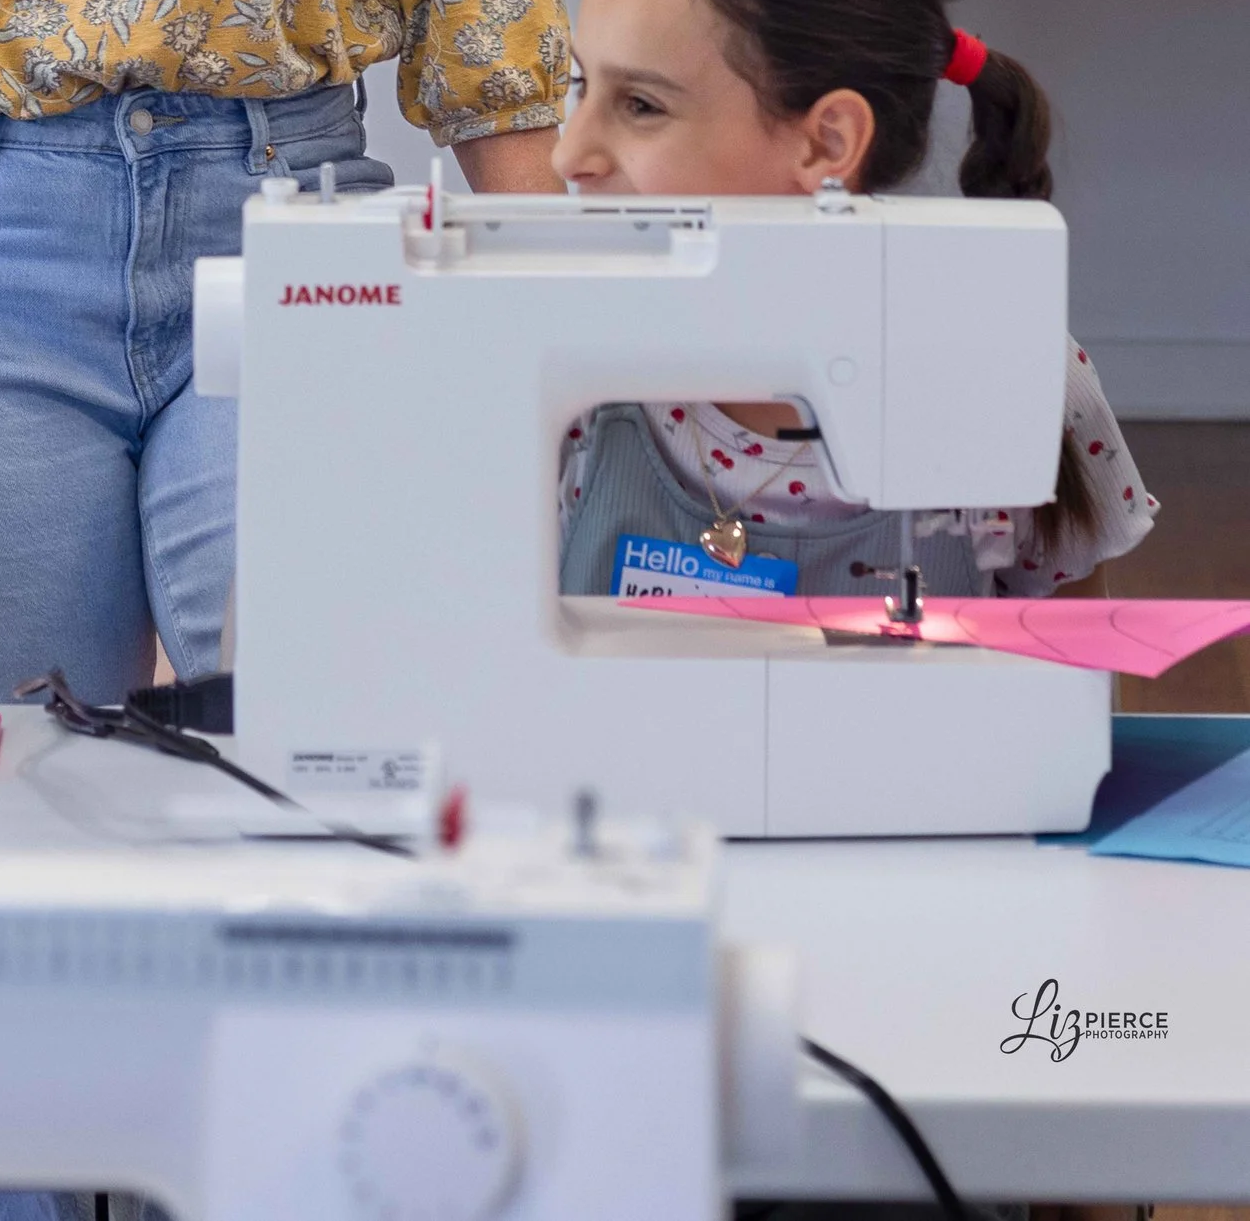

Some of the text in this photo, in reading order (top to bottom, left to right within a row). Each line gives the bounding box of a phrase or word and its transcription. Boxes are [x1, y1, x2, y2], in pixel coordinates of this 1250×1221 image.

[279, 284, 402, 306] JANOME
[624, 540, 775, 589] Hello my name is
